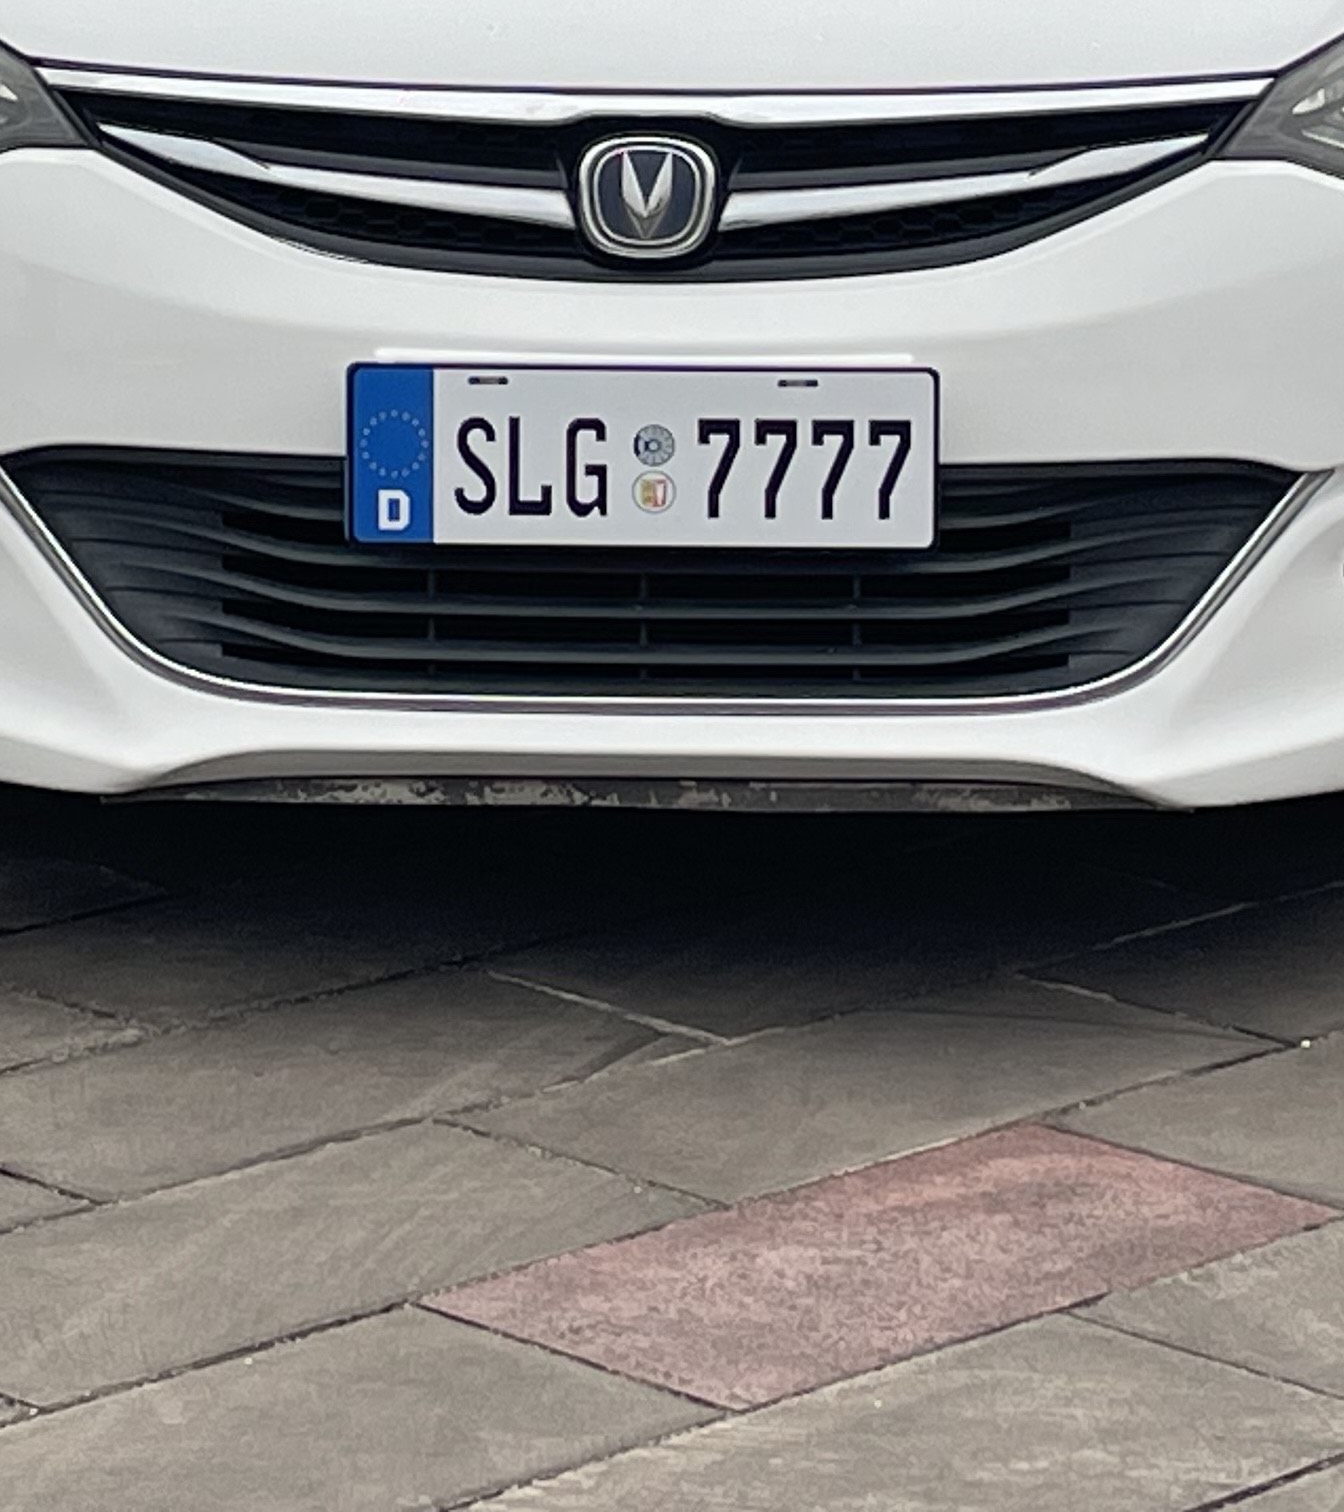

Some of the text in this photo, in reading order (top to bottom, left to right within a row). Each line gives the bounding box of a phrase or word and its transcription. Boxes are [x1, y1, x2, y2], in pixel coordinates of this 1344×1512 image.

[455, 416, 912, 520] SLG 7777
[378, 489, 411, 531] D
